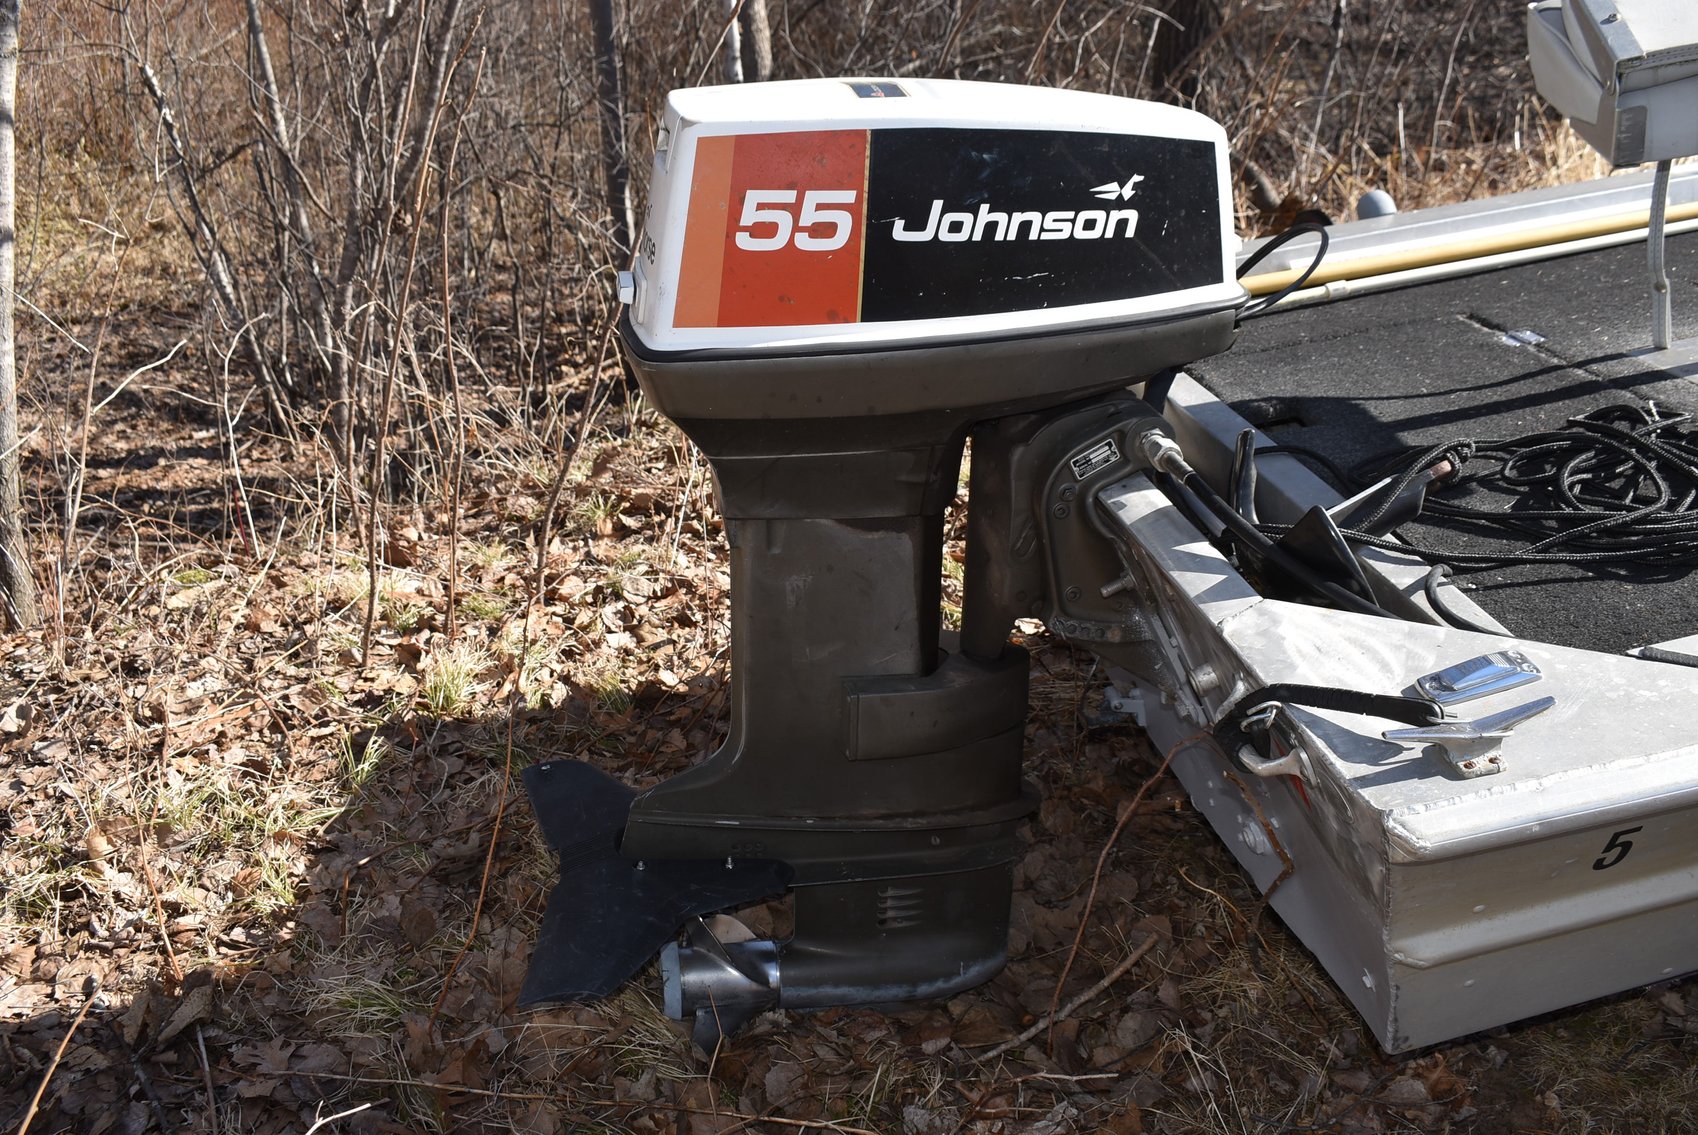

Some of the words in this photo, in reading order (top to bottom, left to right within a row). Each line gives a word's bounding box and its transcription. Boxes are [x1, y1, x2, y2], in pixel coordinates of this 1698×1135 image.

[735, 189, 857, 251] 55
[892, 199, 1139, 242] Johnson
[1592, 825, 1643, 871] 5
